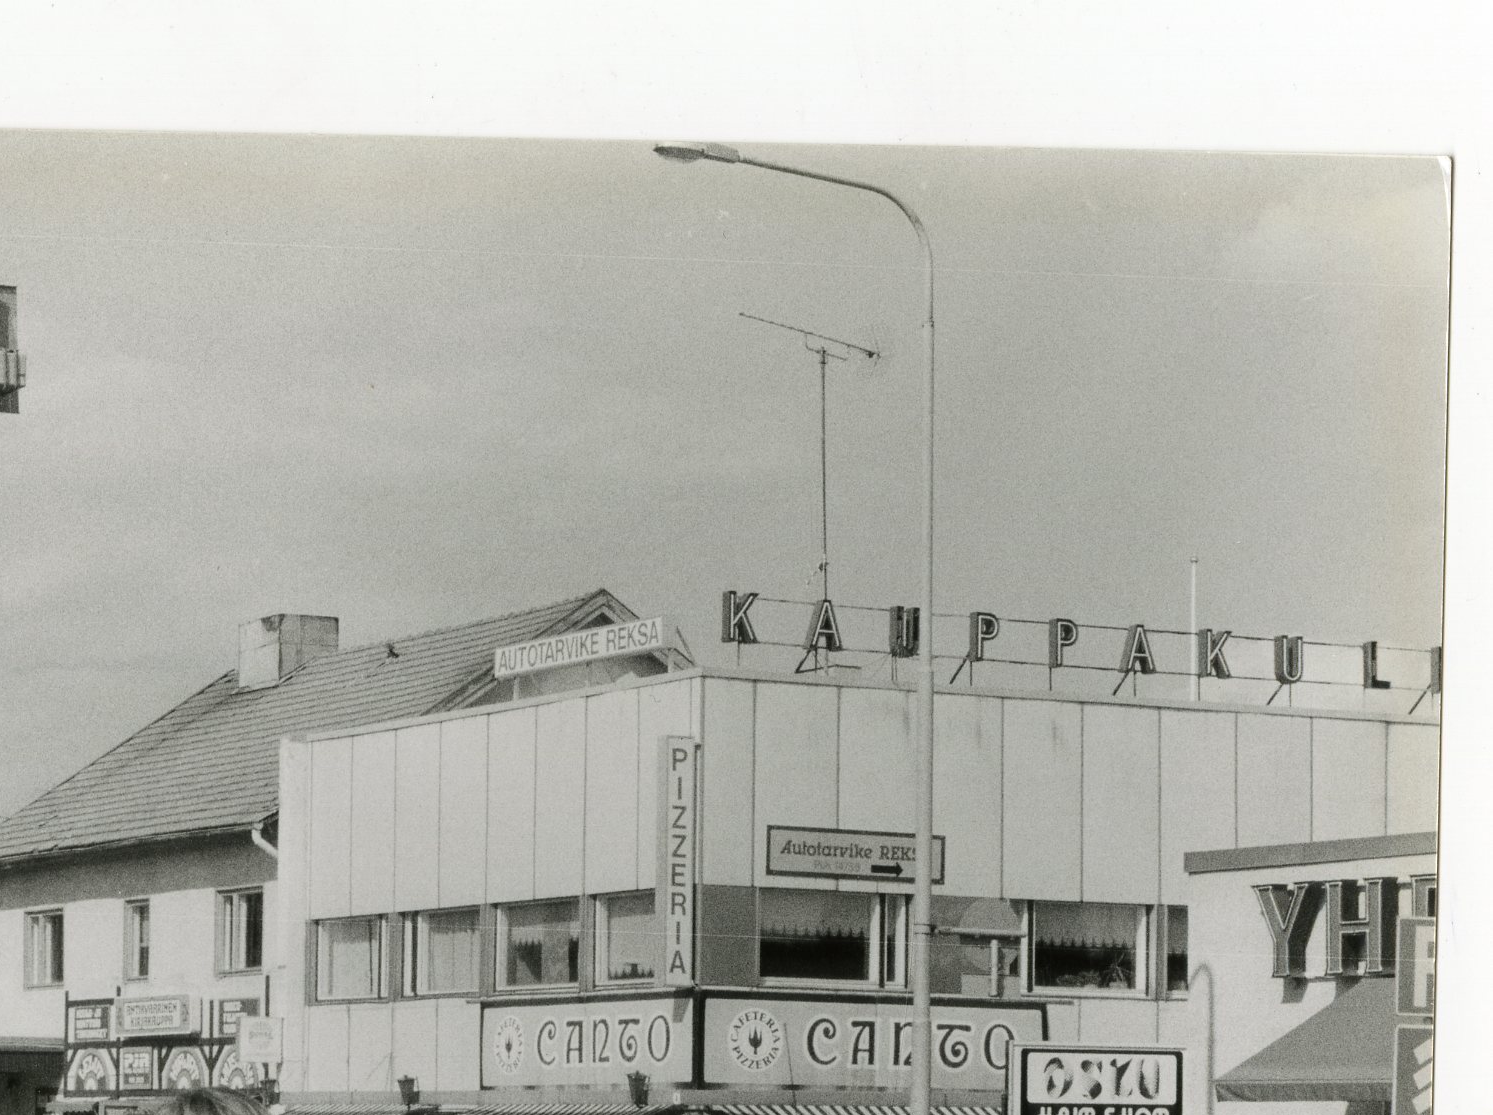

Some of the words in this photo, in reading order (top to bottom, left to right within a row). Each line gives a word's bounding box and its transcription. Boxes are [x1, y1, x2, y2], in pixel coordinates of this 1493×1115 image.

[498, 632, 599, 673] AUTOTARVIKE
[606, 621, 659, 652] REKSA
[669, 747, 688, 975] PIZZERIA
[780, 840, 873, 859] Autotarvike
[1252, 874, 1437, 978] YH
[537, 1015, 670, 1066] CANTO
[730, 1011, 781, 1043] CAFETERIA
[732, 1043, 780, 1070] PIZZERIA
